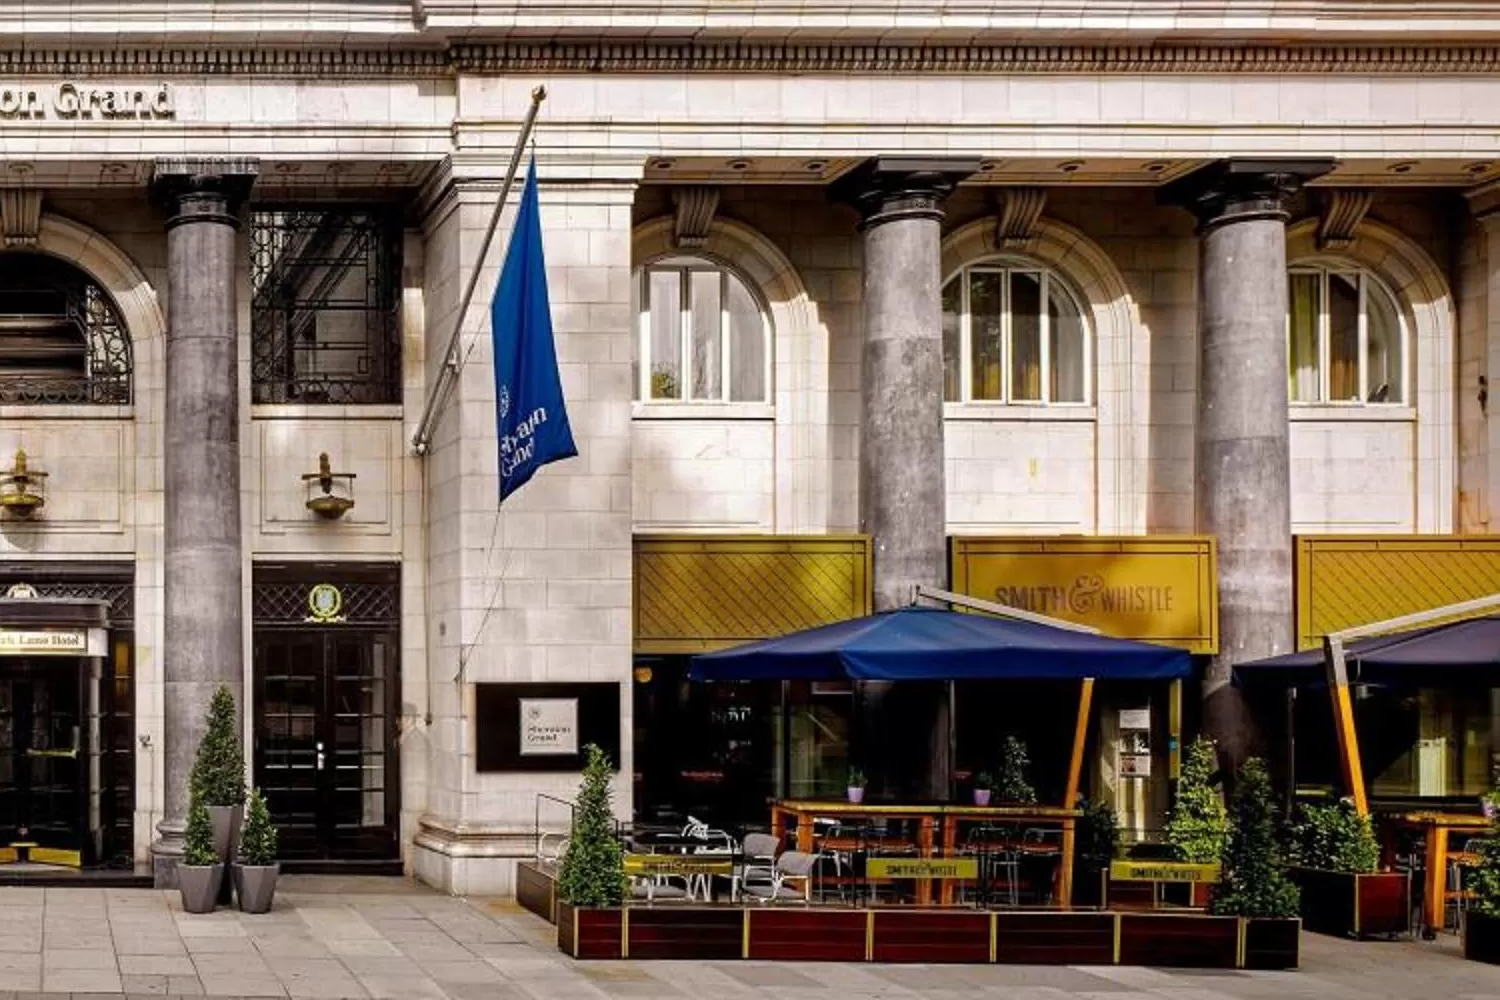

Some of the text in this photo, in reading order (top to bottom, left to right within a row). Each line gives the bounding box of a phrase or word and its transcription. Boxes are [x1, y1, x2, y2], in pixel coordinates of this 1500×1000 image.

[54, 80, 176, 118] Grand
[995, 585, 1068, 612] SMITH
[1102, 585, 1173, 612] WHISTLE
[19, 635, 49, 646] Lane
[51, 635, 80, 646] Hotel
